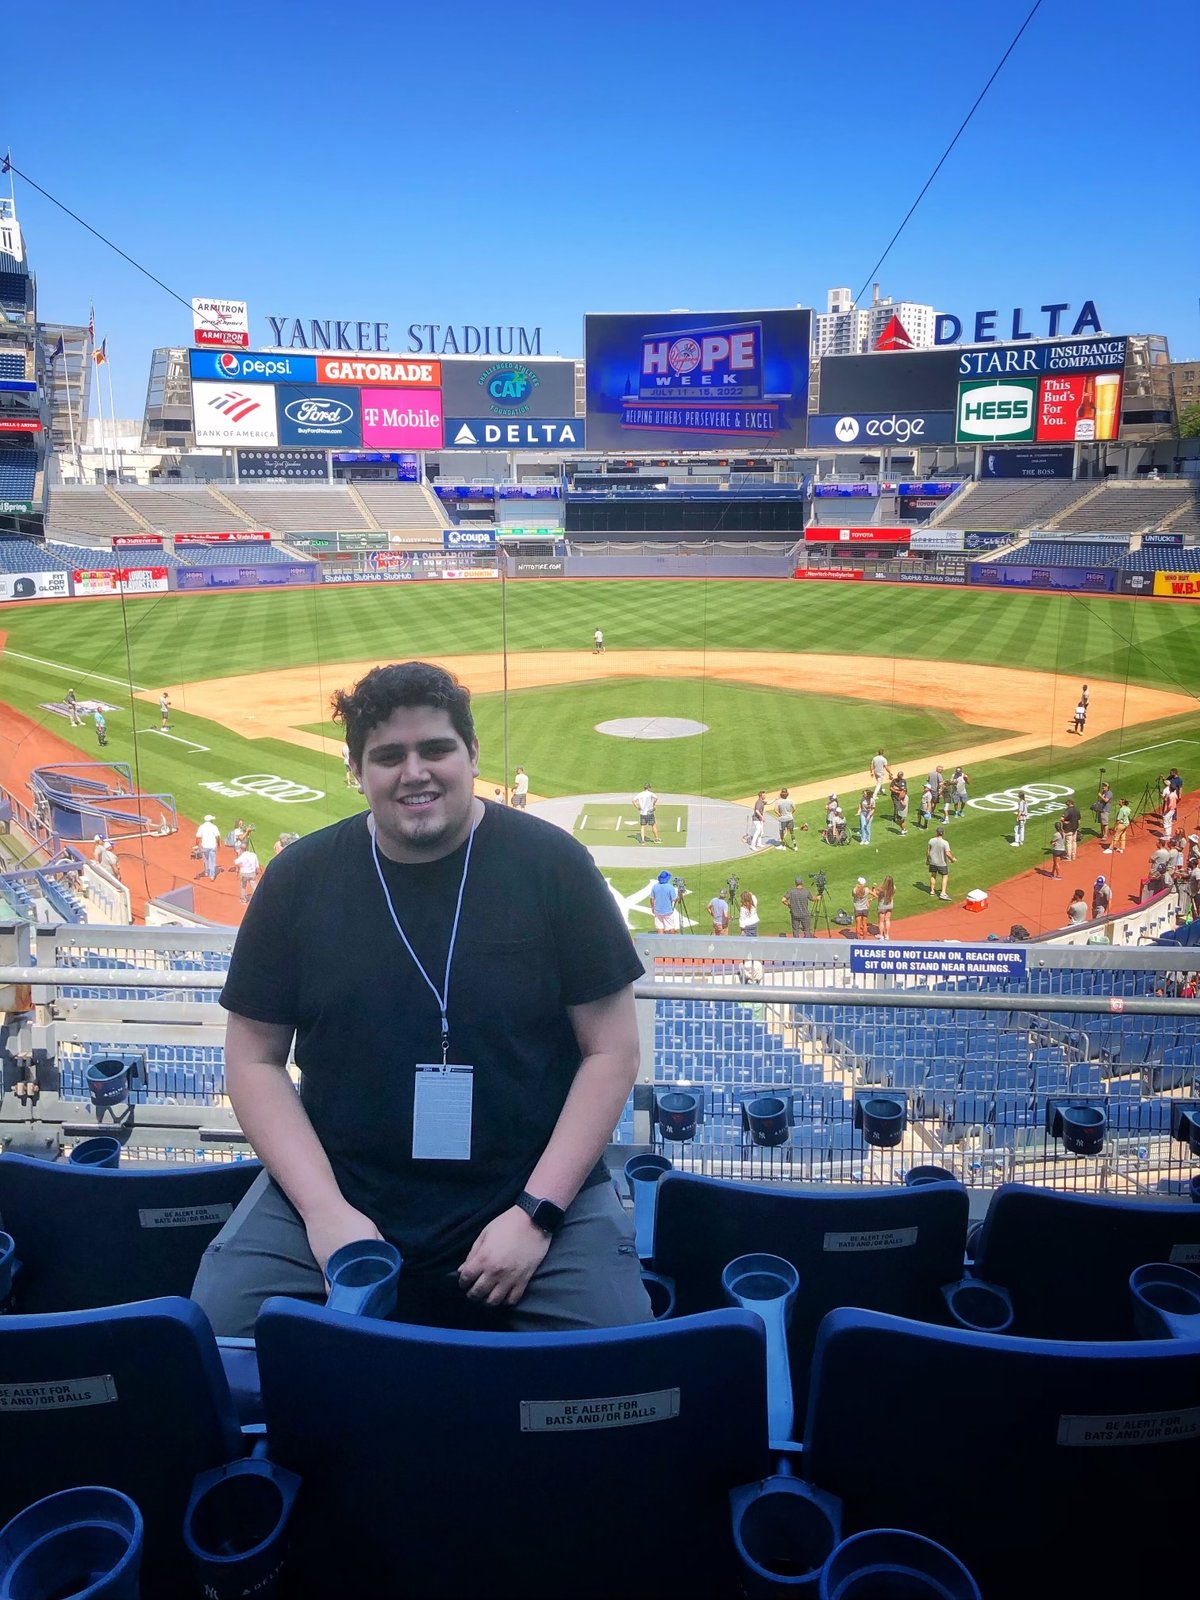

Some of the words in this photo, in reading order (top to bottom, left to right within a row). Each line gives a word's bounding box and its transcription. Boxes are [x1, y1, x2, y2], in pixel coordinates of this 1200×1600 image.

[198, 303, 244, 314] ARMITRON
[934, 300, 1103, 345] DELTA
[202, 331, 243, 341] ARMITRON
[265, 316, 390, 352] YANKEE
[407, 323, 543, 356] STADIUM
[642, 331, 755, 375] HOPE
[1050, 341, 1126, 358] INSURANCE
[959, 349, 1041, 374] STARR
[1050, 352, 1125, 369] COMPANIES
[242, 359, 290, 377] pepsi
[325, 361, 433, 382] GATORADE
[478, 362, 513, 386] CHALLENGED
[655, 374, 737, 386] WEEK
[1044, 379, 1071, 391] This
[490, 380, 527, 398] CAF
[650, 388, 674, 397] JULY
[677, 388, 687, 396] 11
[716, 387, 744, 396] 2022
[1044, 391, 1075, 403] Bud's
[297, 401, 342, 423] Ford
[489, 404, 531, 416] FOUNDATION
[965, 400, 1028, 421] HESS
[1043, 403, 1062, 414] For
[625, 409, 653, 424] HELPING
[655, 410, 682, 425] OTHERS
[685, 410, 731, 427] PERSEVERE
[734, 411, 741, 428] &
[745, 412, 774, 430] EXCEL
[1042, 415, 1067, 426] You.
[197, 429, 221, 437] BANK
[223, 430, 234, 438] OF
[236, 430, 275, 438] AMERICA
[298, 427, 343, 435] BuyFordNow.com
[485, 424, 576, 443] DELTA
[866, 414, 925, 443] edge
[461, 533, 490, 544] coupa
[383, 572, 412, 580] StubHub
[901, 573, 921, 581] StubHub
[198, 781, 251, 798] Audi
[854, 948, 887, 959] PLEASE
[888, 950, 901, 959] DO
[903, 950, 922, 960] NOT
[923, 951, 946, 960] LEAN
[948, 951, 964, 961] ON,
[966, 952, 995, 961] REACH
[997, 953, 1023, 962] OVER,
[864, 960, 879, 969] SIT
[881, 961, 894, 970] ON
[895, 961, 908, 970] OR
[909, 962, 940, 971] STAND
[942, 963, 966, 972] NEAR
[967, 964, 1011, 973] RAILINGS.
[0, 1388, 9, 1397] BE
[13, 1387, 46, 1397] ALERT
[49, 1385, 71, 1395] FOR
[10, 1395, 56, 1406] AND/OR
[58, 1392, 92, 1403] BALLS
[564, 1406, 578, 1415] BE
[581, 1403, 615, 1414] ALERT
[618, 1401, 638, 1410] FOR
[545, 1416, 574, 1425] BATS
[576, 1412, 621, 1424] AND/OR
[624, 1407, 656, 1419] BALLS
[1105, 1422, 1120, 1430] BE
[1123, 1419, 1158, 1430] ALERT
[1161, 1416, 1181, 1425] FOR
[1084, 1431, 1114, 1441] BATS
[1116, 1428, 1162, 1440] AND/OR
[1164, 1423, 1197, 1436] BALLS
